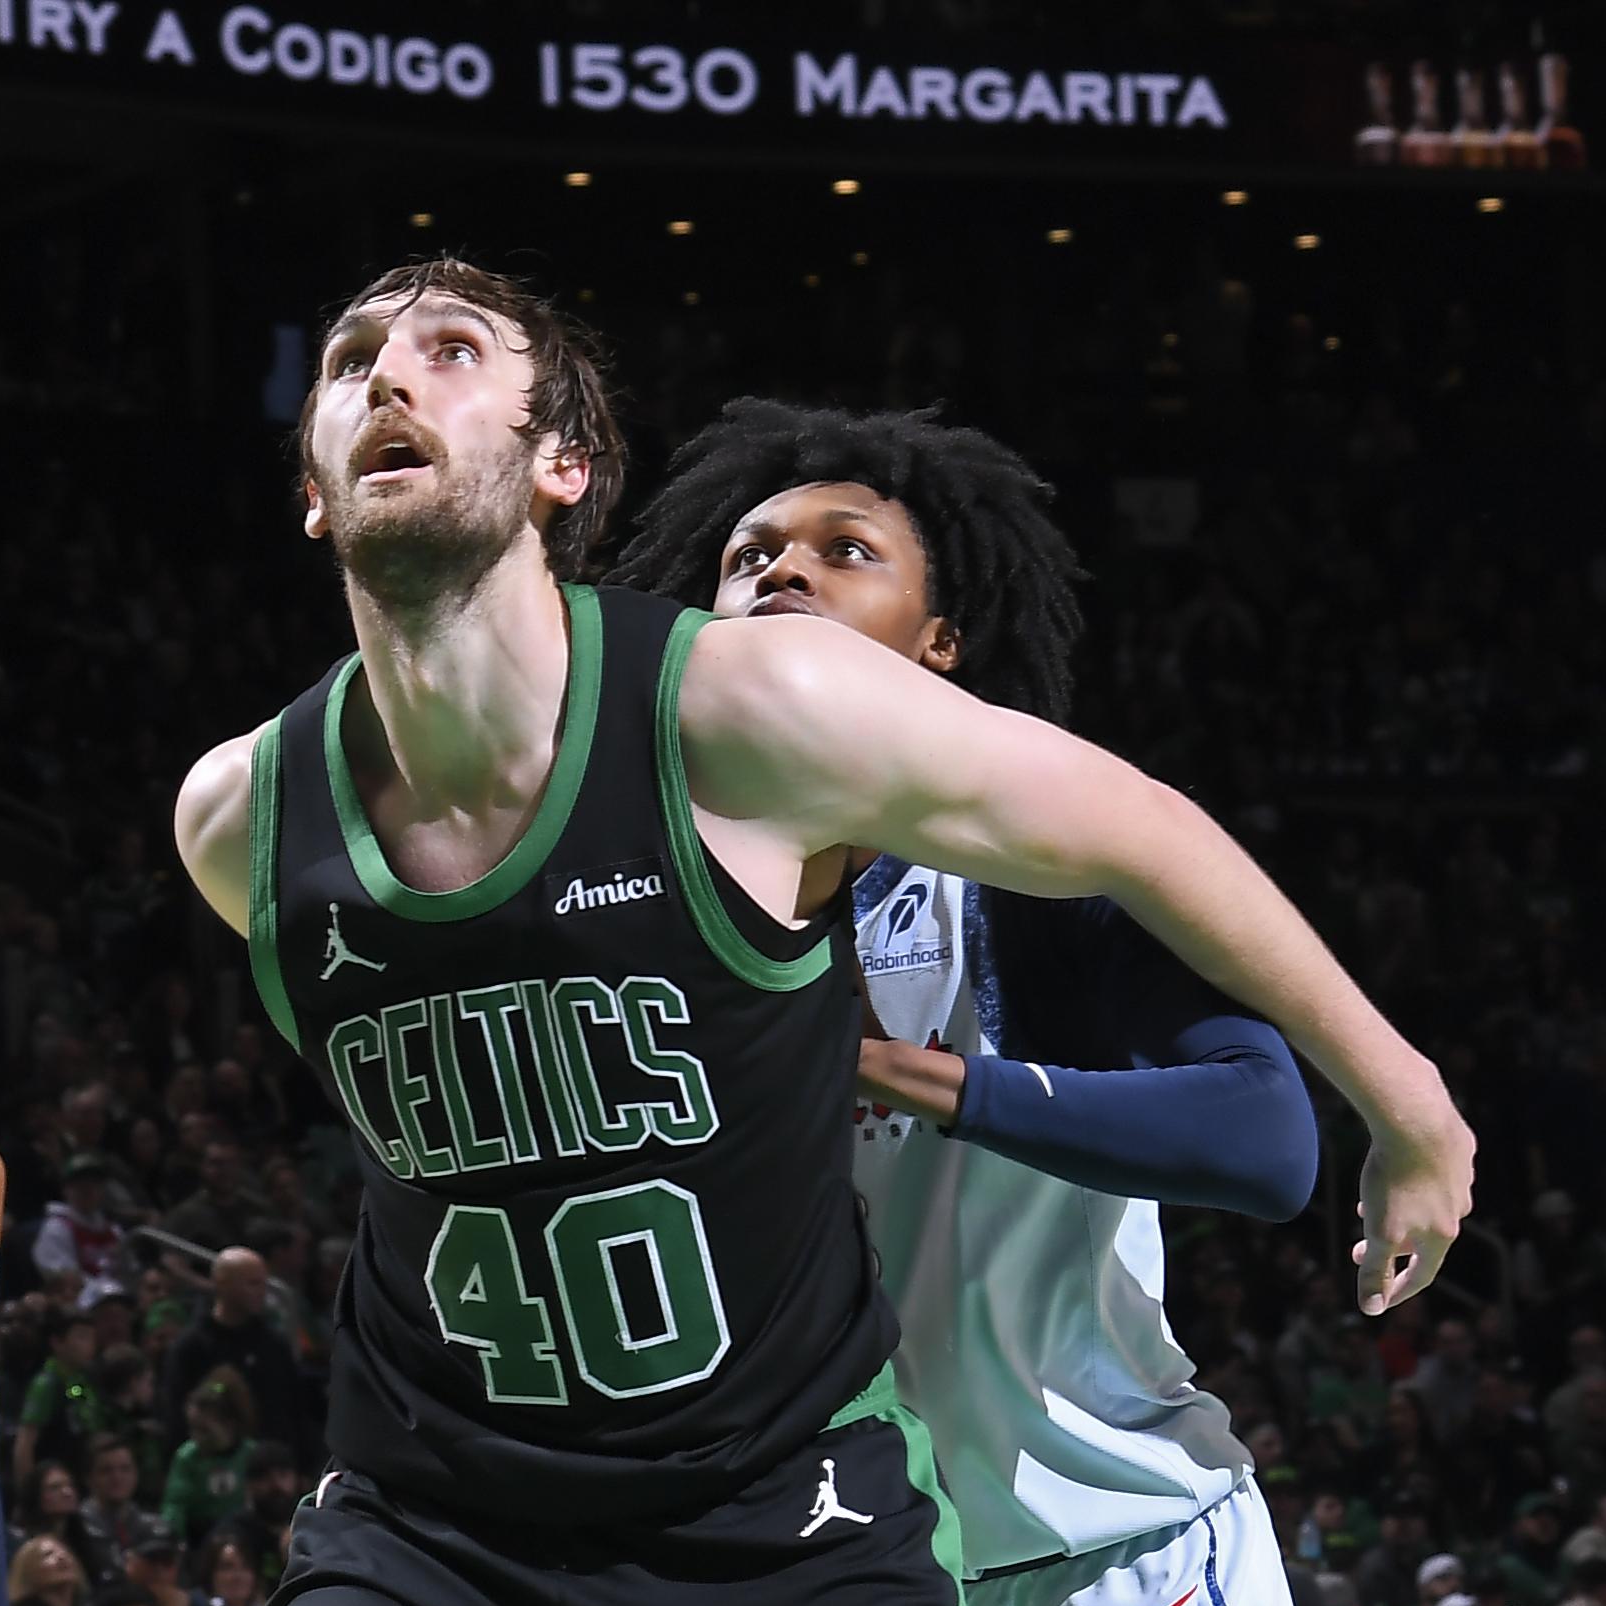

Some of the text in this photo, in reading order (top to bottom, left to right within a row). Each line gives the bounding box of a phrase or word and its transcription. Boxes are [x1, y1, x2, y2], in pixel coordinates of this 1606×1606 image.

[540, 43, 758, 113] 1530
[795, 52, 1228, 127] MARGARITA
[554, 874, 665, 915] Amica
[325, 975, 721, 1181] CELTICS
[424, 1178, 733, 1407] 40
